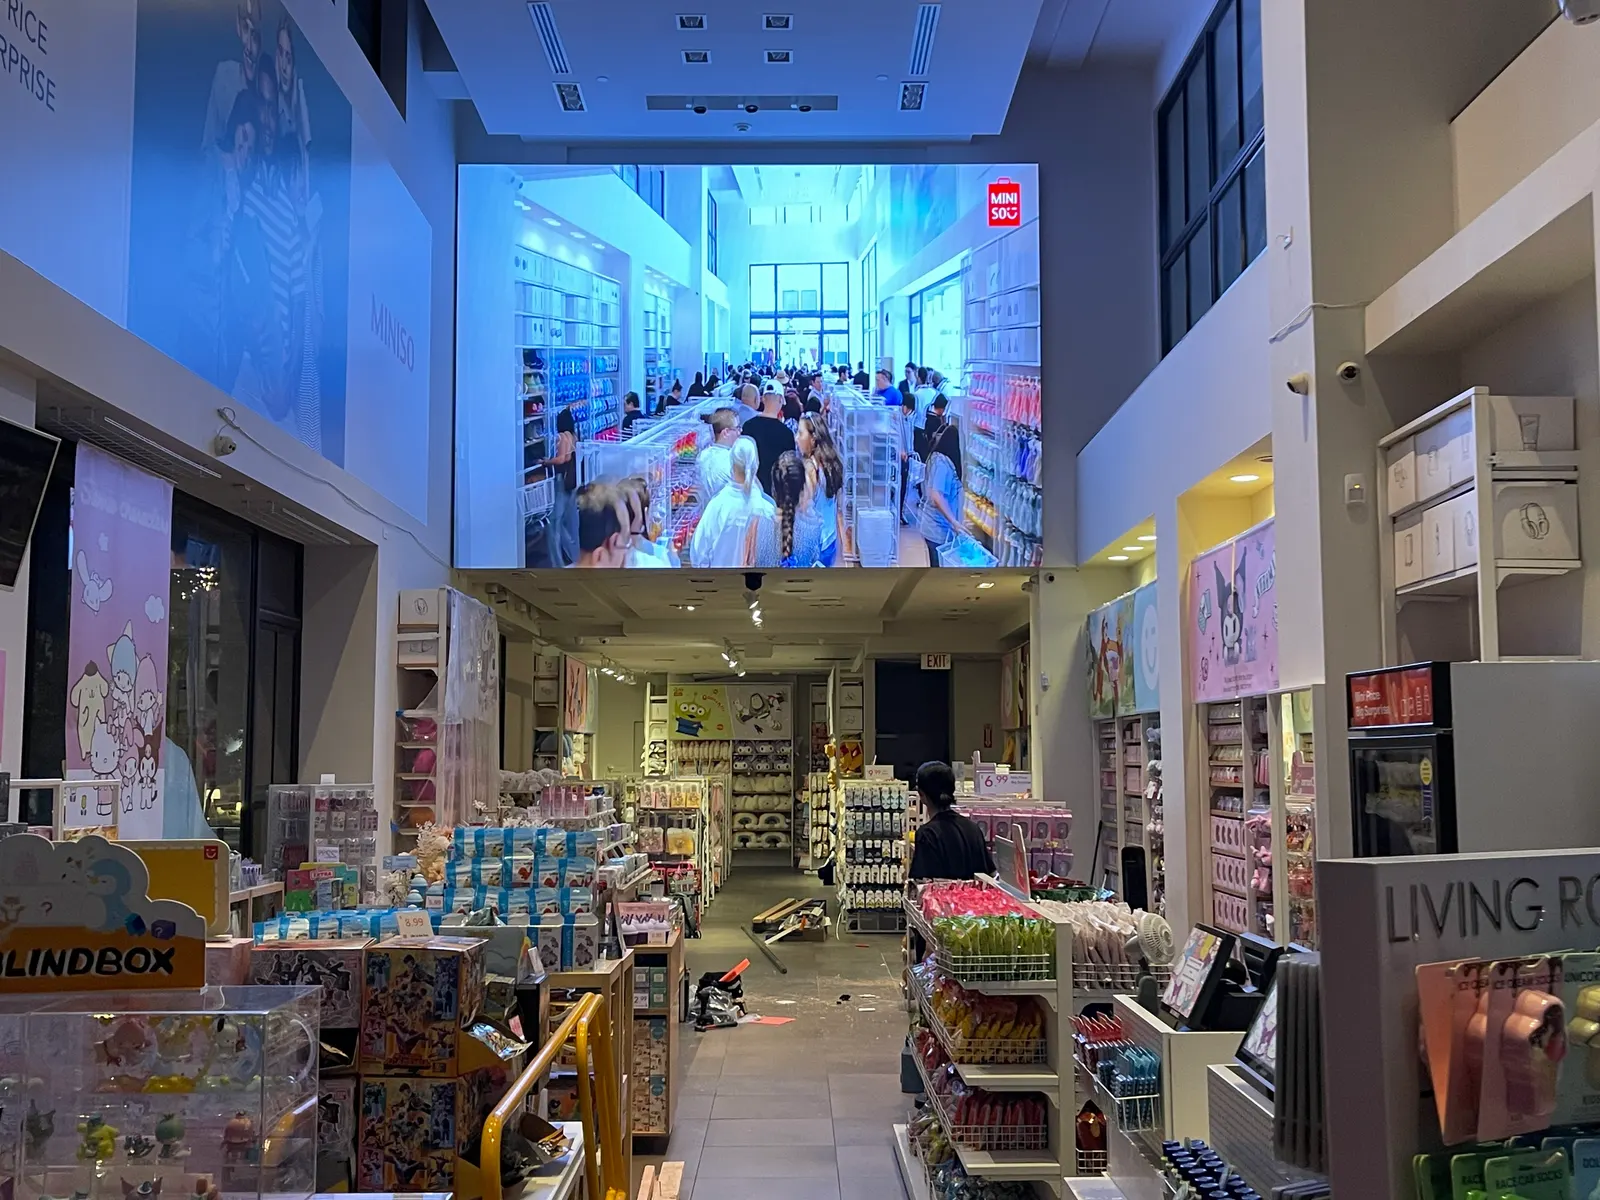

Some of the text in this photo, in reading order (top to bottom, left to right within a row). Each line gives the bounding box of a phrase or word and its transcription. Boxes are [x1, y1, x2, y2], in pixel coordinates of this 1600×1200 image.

[1, 0, 48, 55] RICE
[991, 192, 1018, 204] MINI
[371, 289, 415, 373] MINISO
[926, 655, 947, 668] EXIT
[405, 917, 424, 927] 8.99
[1386, 877, 1544, 944] LIVING
[0, 947, 175, 977] LINDBOX
